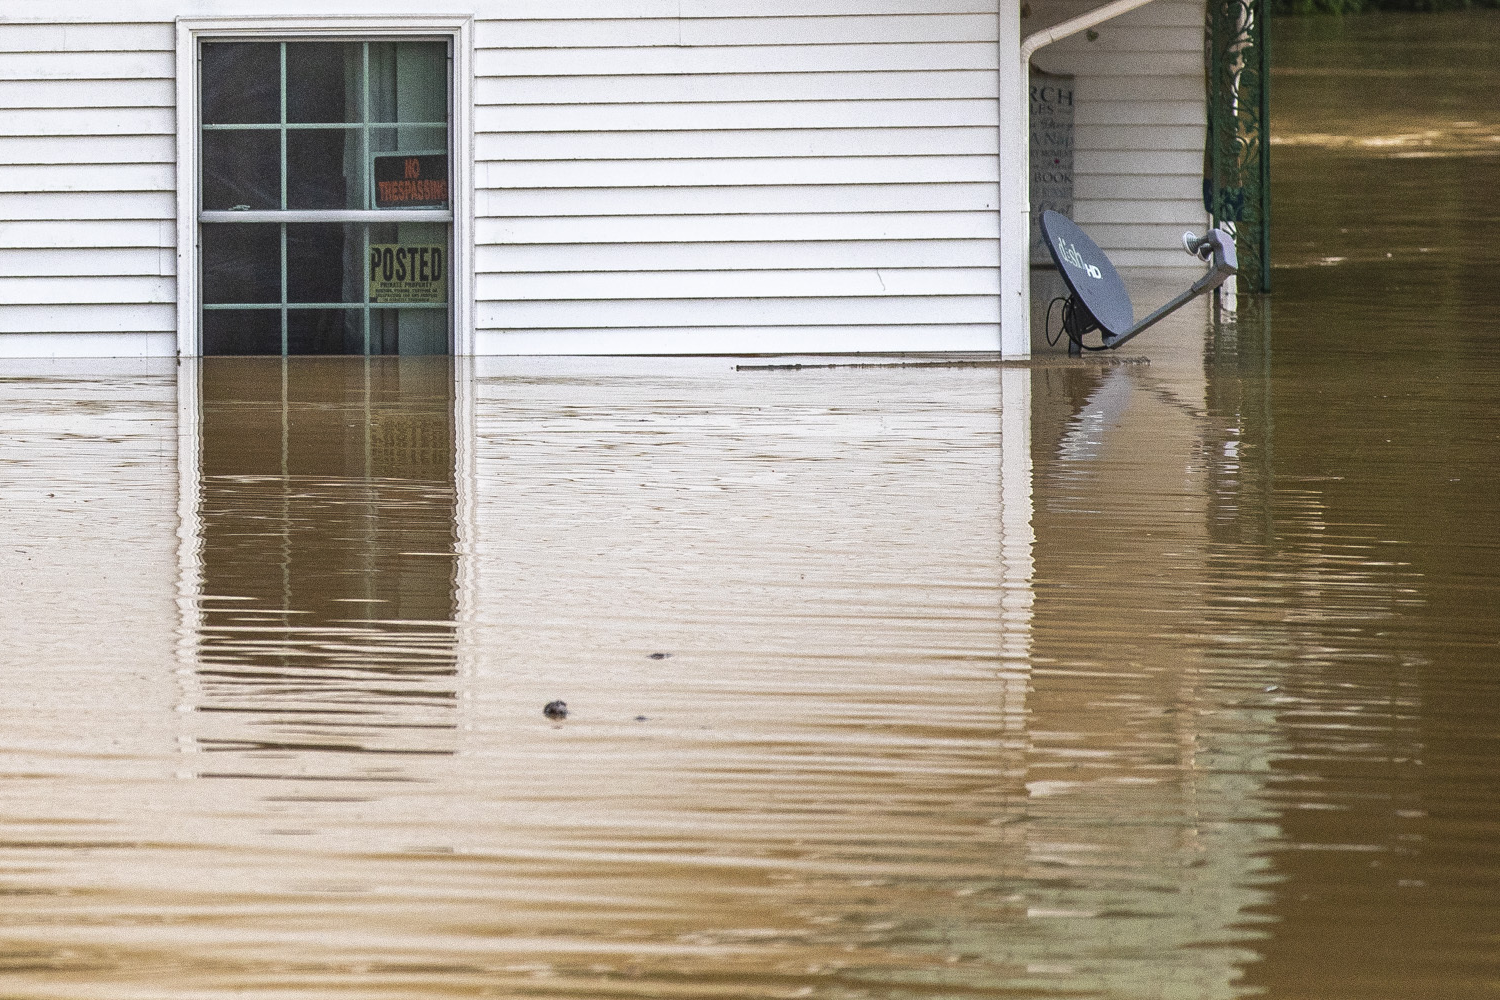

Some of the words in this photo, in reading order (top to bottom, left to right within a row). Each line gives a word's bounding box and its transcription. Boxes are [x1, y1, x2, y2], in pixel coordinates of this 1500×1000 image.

[1029, 85, 1073, 106] RCH
[1030, 104, 1054, 115] LES
[405, 158, 419, 178] NO
[1034, 172, 1072, 183] BOOK
[379, 180, 447, 201] TRESPASSING
[371, 247, 442, 281] POSTED
[1058, 237, 1084, 269] dish
[1084, 263, 1102, 279] HD
